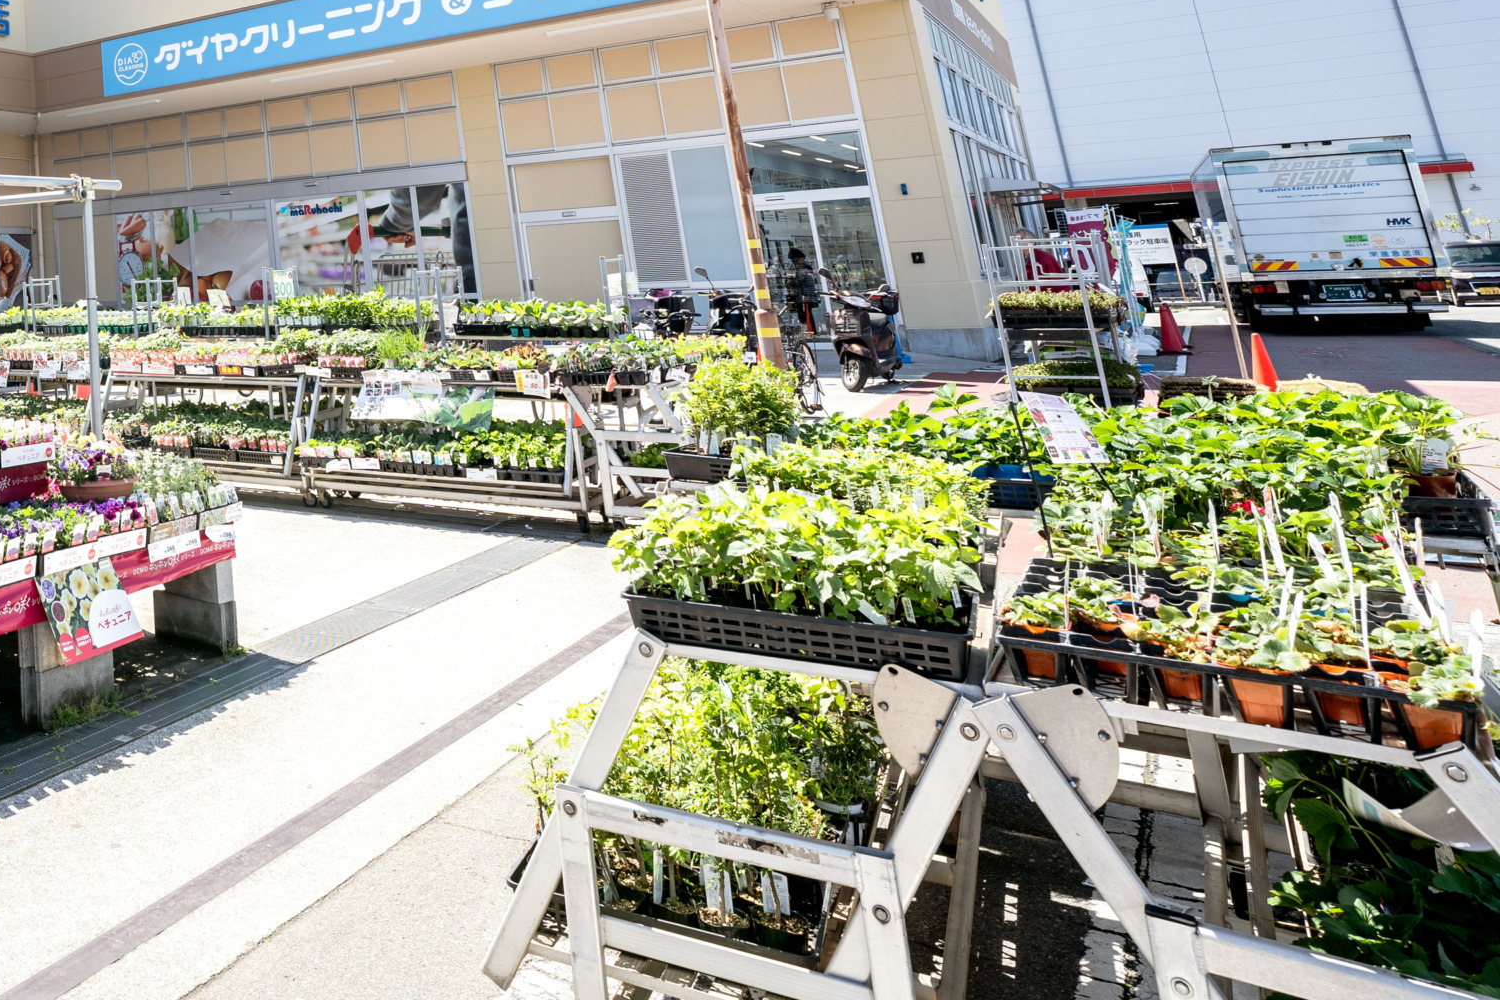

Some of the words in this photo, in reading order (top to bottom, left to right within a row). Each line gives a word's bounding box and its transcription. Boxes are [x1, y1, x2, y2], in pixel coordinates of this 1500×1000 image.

[117, 57, 133, 67] DIA
[1267, 158, 1355, 172] EXPRESS
[1271, 168, 1356, 187] EISHIN
[1386, 217, 1412, 226] HMK
[274, 281, 293, 296] 300
[97, 610, 132, 630] ペチュニア
